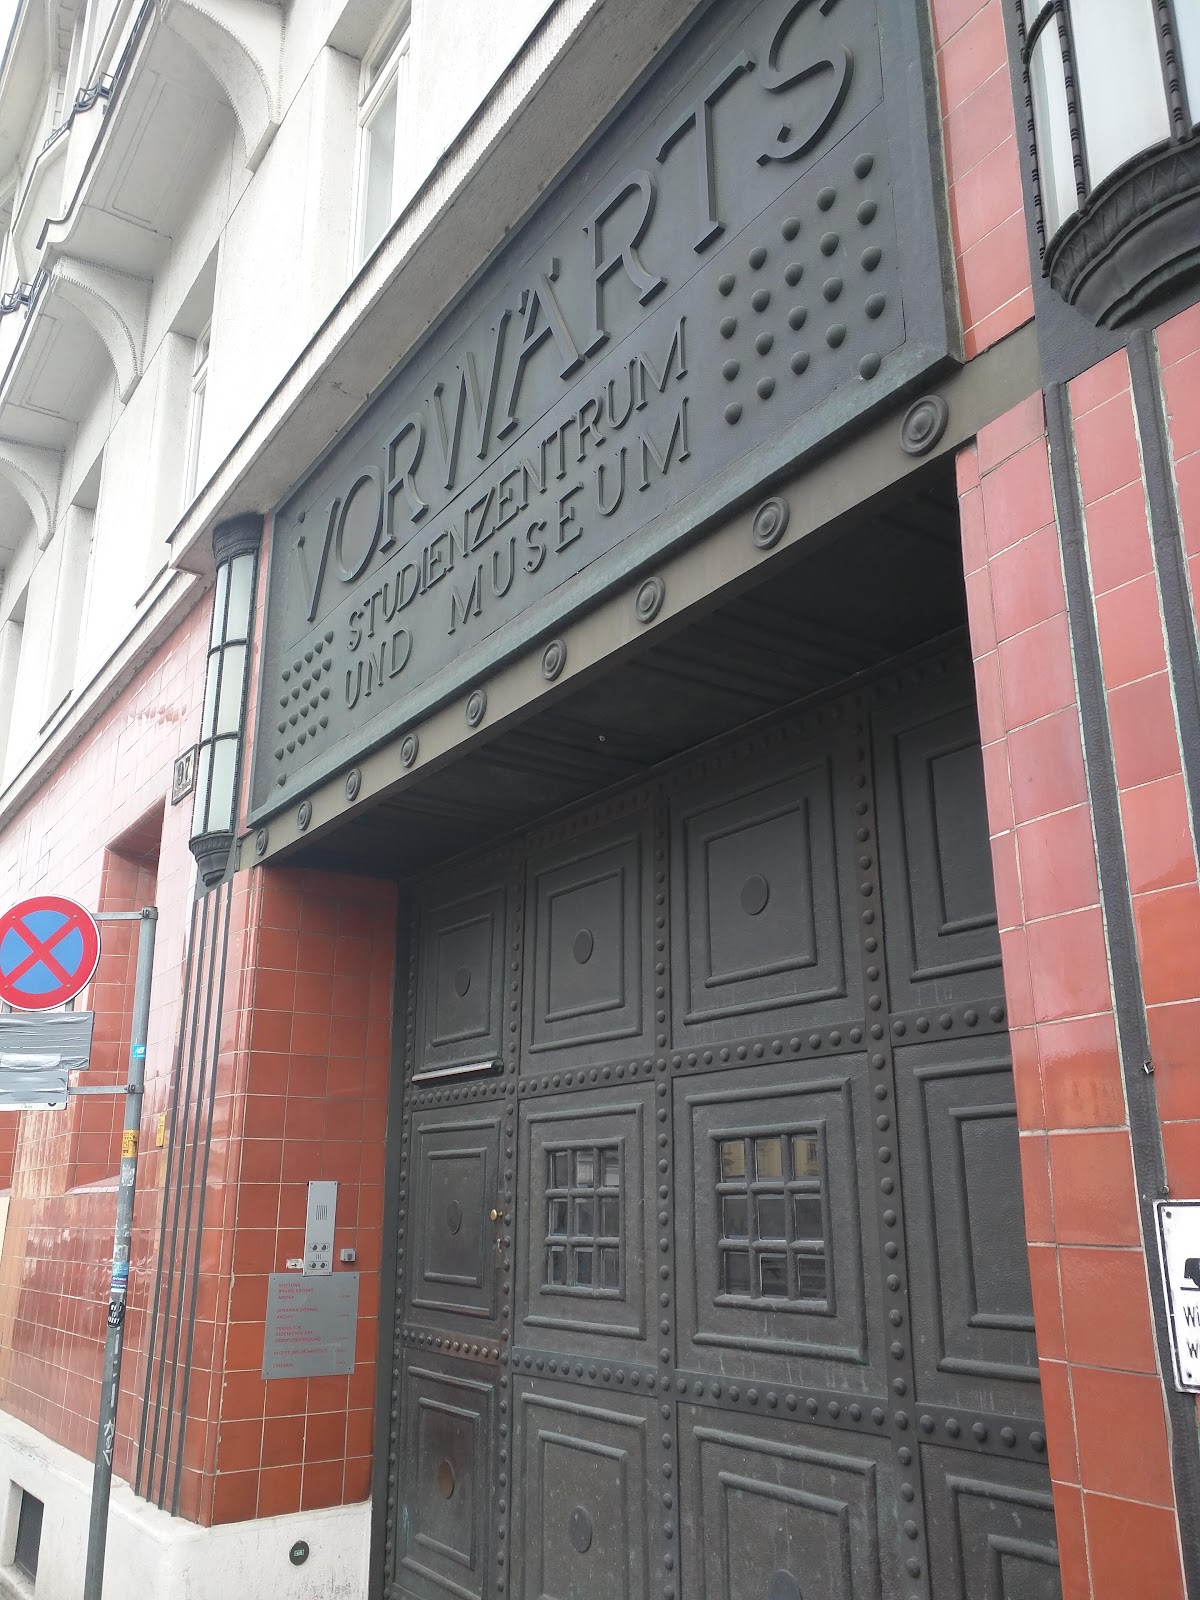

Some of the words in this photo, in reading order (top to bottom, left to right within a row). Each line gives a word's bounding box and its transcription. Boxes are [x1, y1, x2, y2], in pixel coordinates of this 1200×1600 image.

[290, 0, 854, 622] VORWÄRTS
[345, 627, 414, 709] UND
[447, 395, 692, 635] MUSEUM
[348, 315, 689, 651] STUDIENZENTRUM
